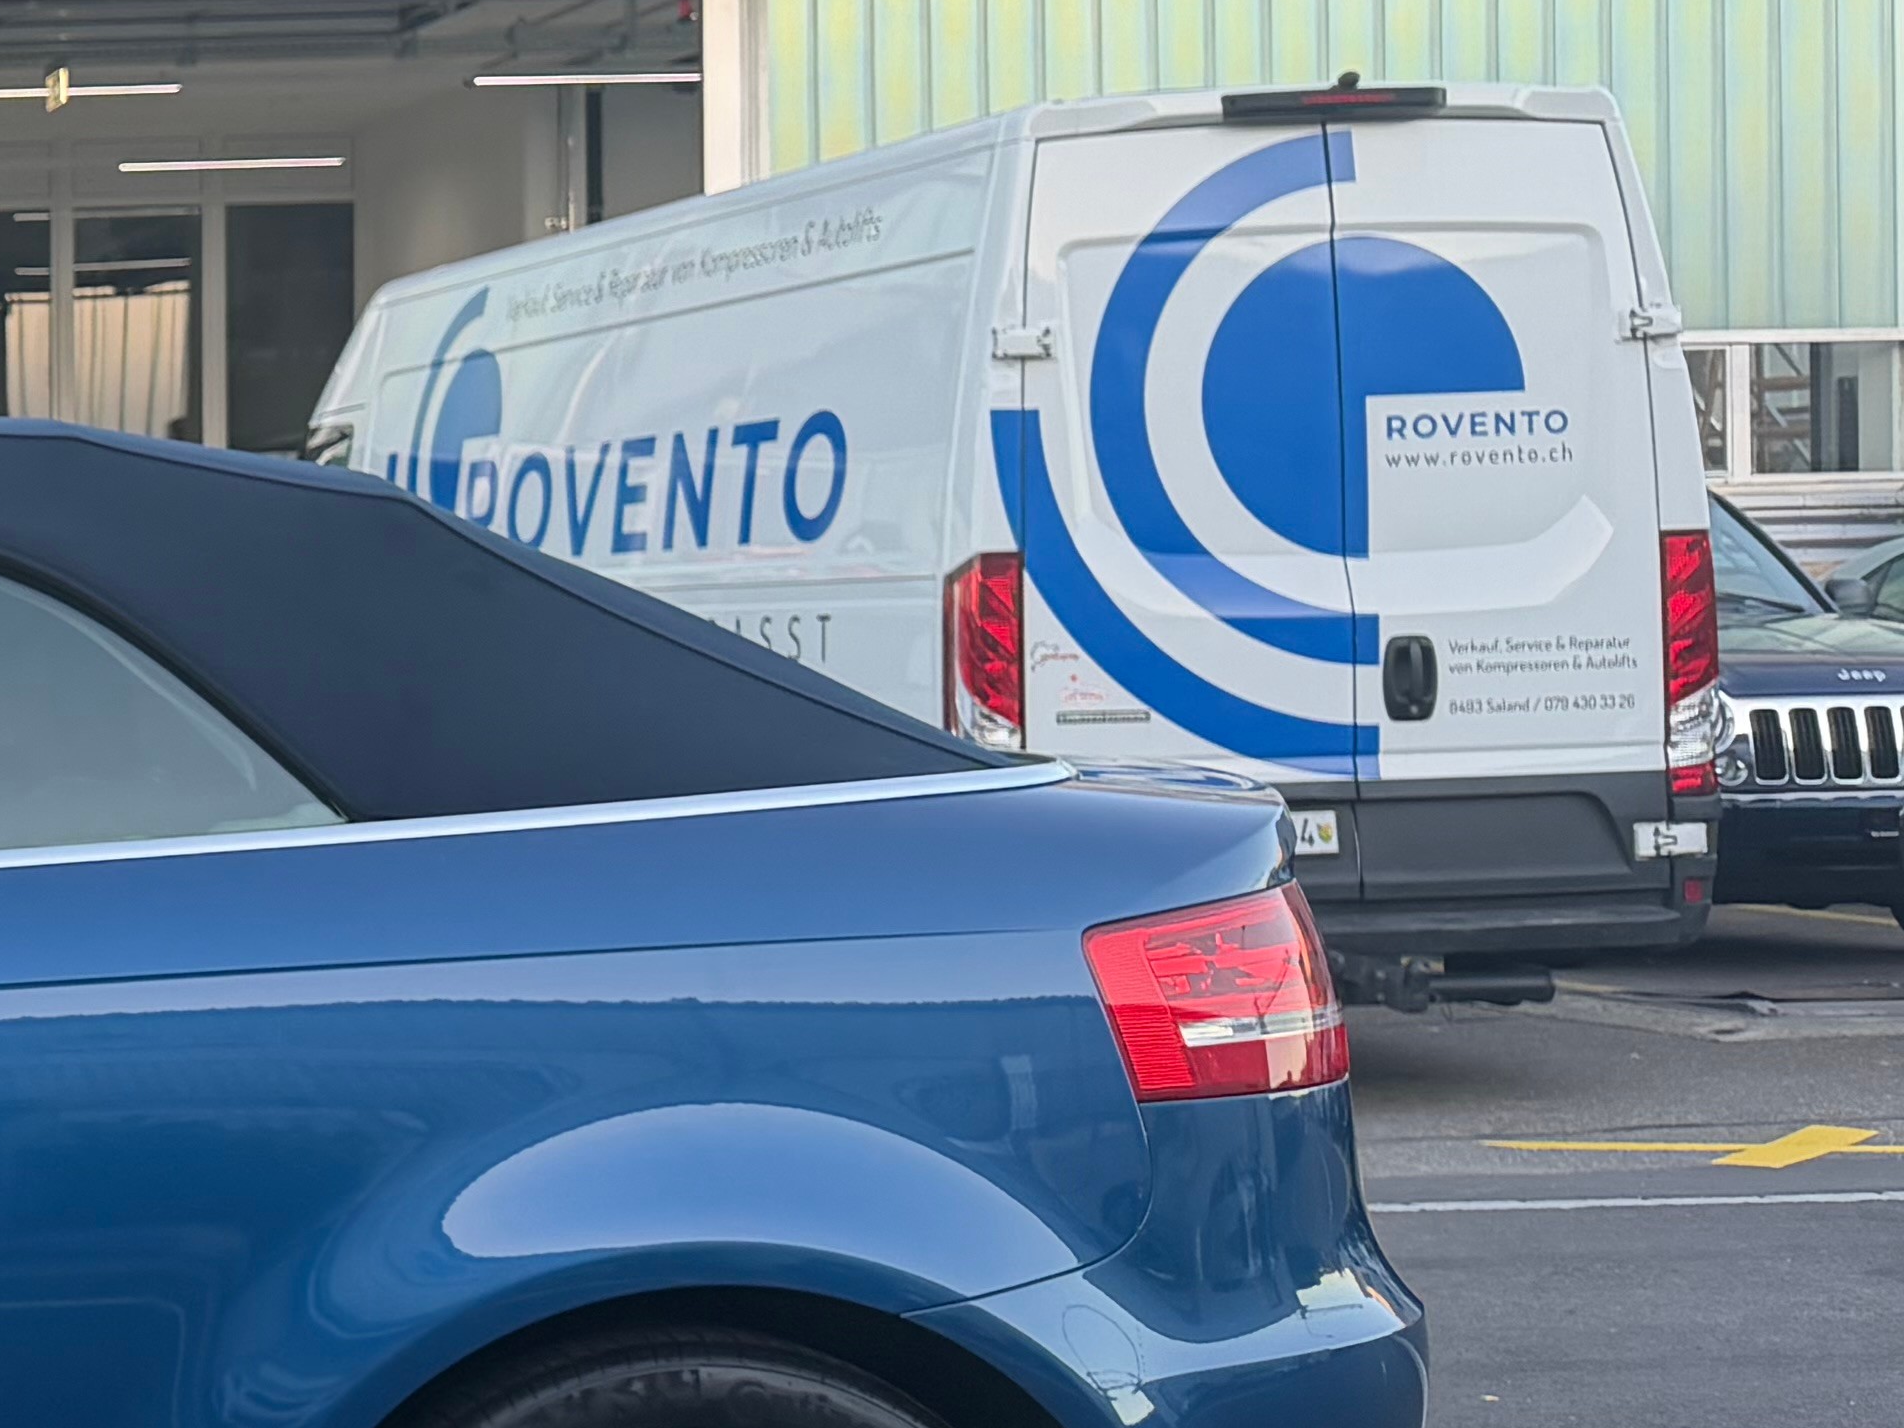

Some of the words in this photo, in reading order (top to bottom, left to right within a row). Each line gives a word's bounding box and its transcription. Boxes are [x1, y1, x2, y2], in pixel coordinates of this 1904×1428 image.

[1385, 408, 1569, 441] ROVENTO
[1384, 441, 1573, 469] www.rovento.ch
[465, 409, 848, 557] ROVENTO
[1505, 636, 1553, 654] Service
[1555, 634, 1566, 652] &
[1568, 634, 1631, 652] Reparatur
[1448, 661, 1473, 675] von
[1476, 658, 1570, 676] Kompressoren
[1572, 654, 1583, 671] &
[1585, 653, 1638, 670] Autolifts
[1837, 668, 1887, 682] Jeep
